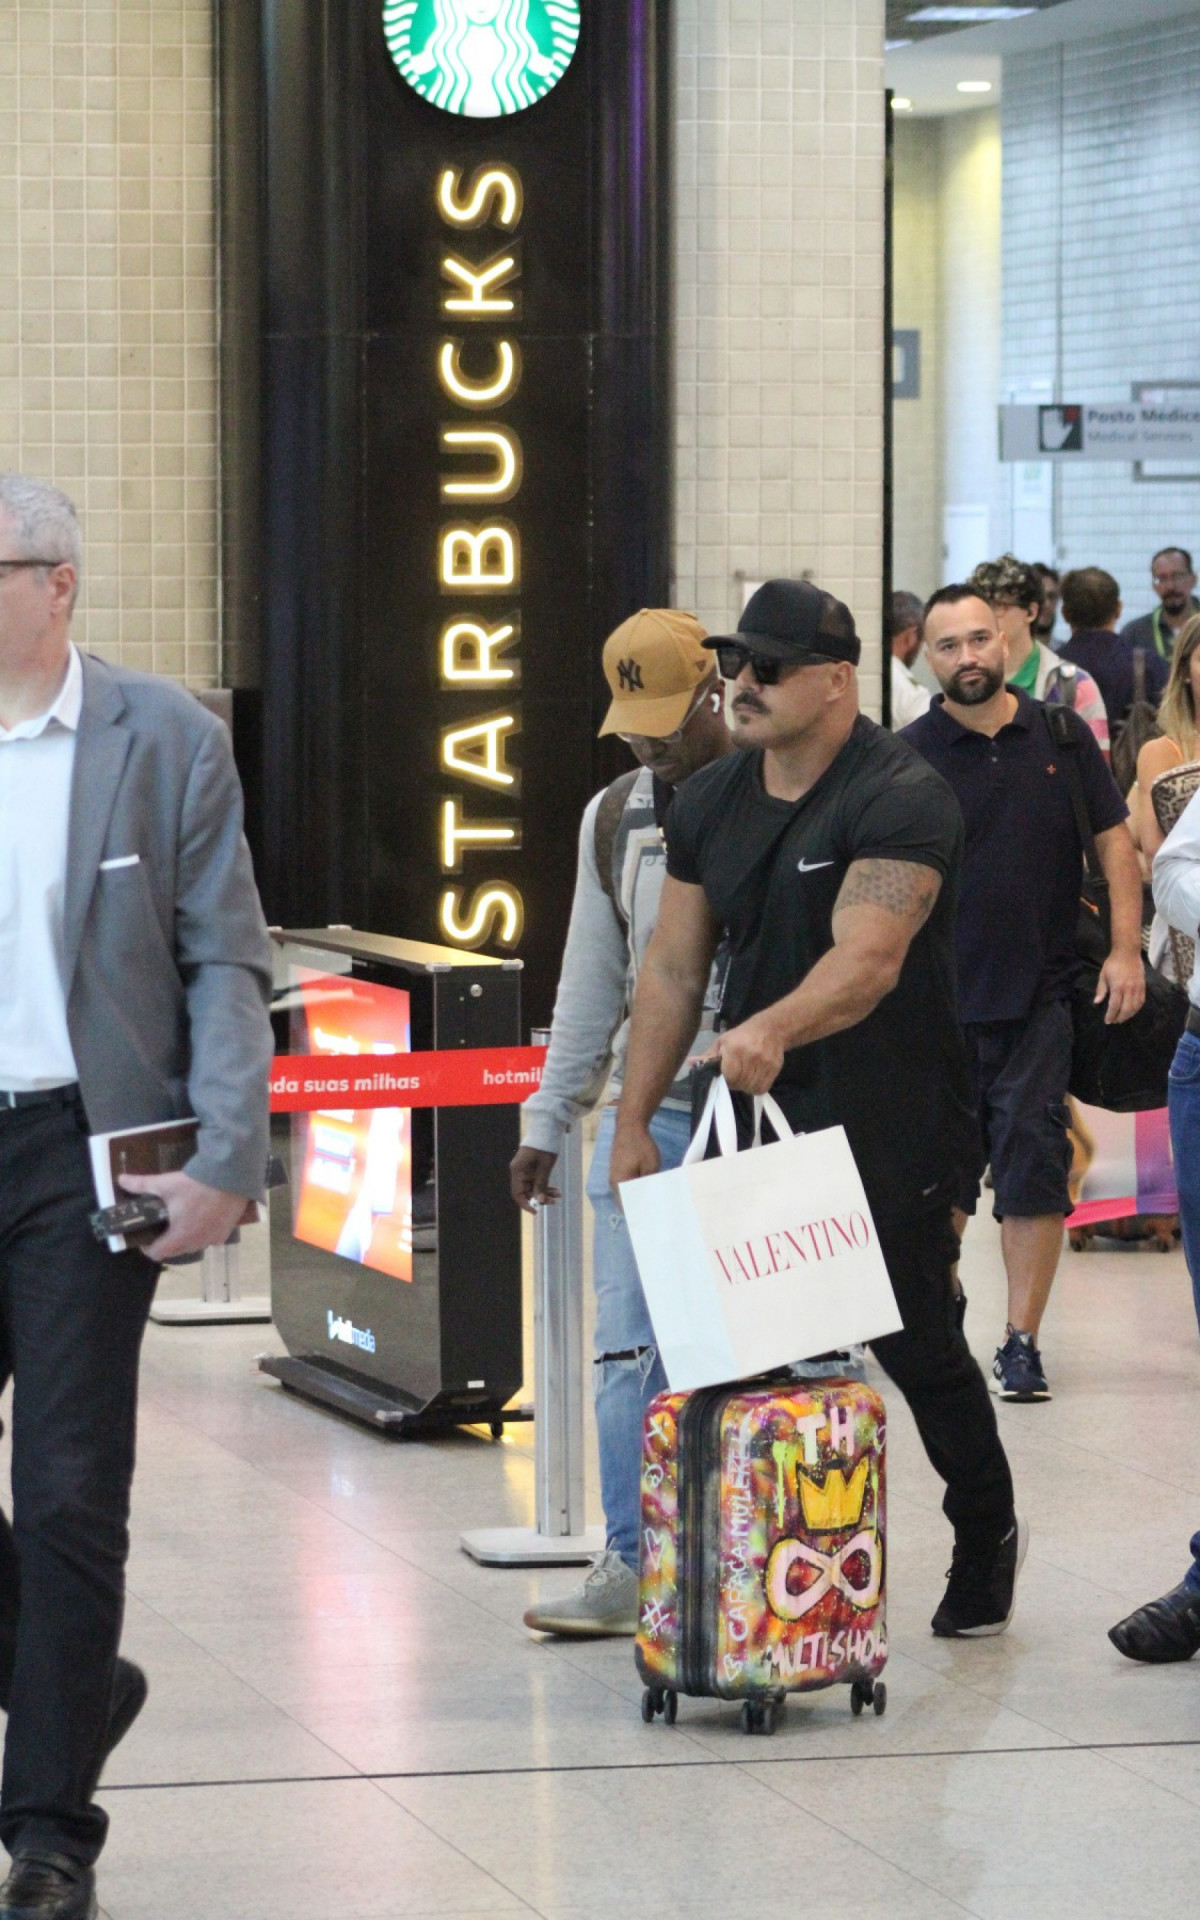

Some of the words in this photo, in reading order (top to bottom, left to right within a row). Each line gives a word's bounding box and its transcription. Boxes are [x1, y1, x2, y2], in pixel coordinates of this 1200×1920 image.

[440, 164, 523, 949] STARBUCKS
[617, 658, 645, 692] NY
[304, 1077, 350, 1093] suas
[354, 1071, 420, 1092] milhas
[714, 1209, 870, 1285] VALENTINO
[797, 1405, 855, 1465] TH
[763, 1627, 888, 1680] MULTISHOW
